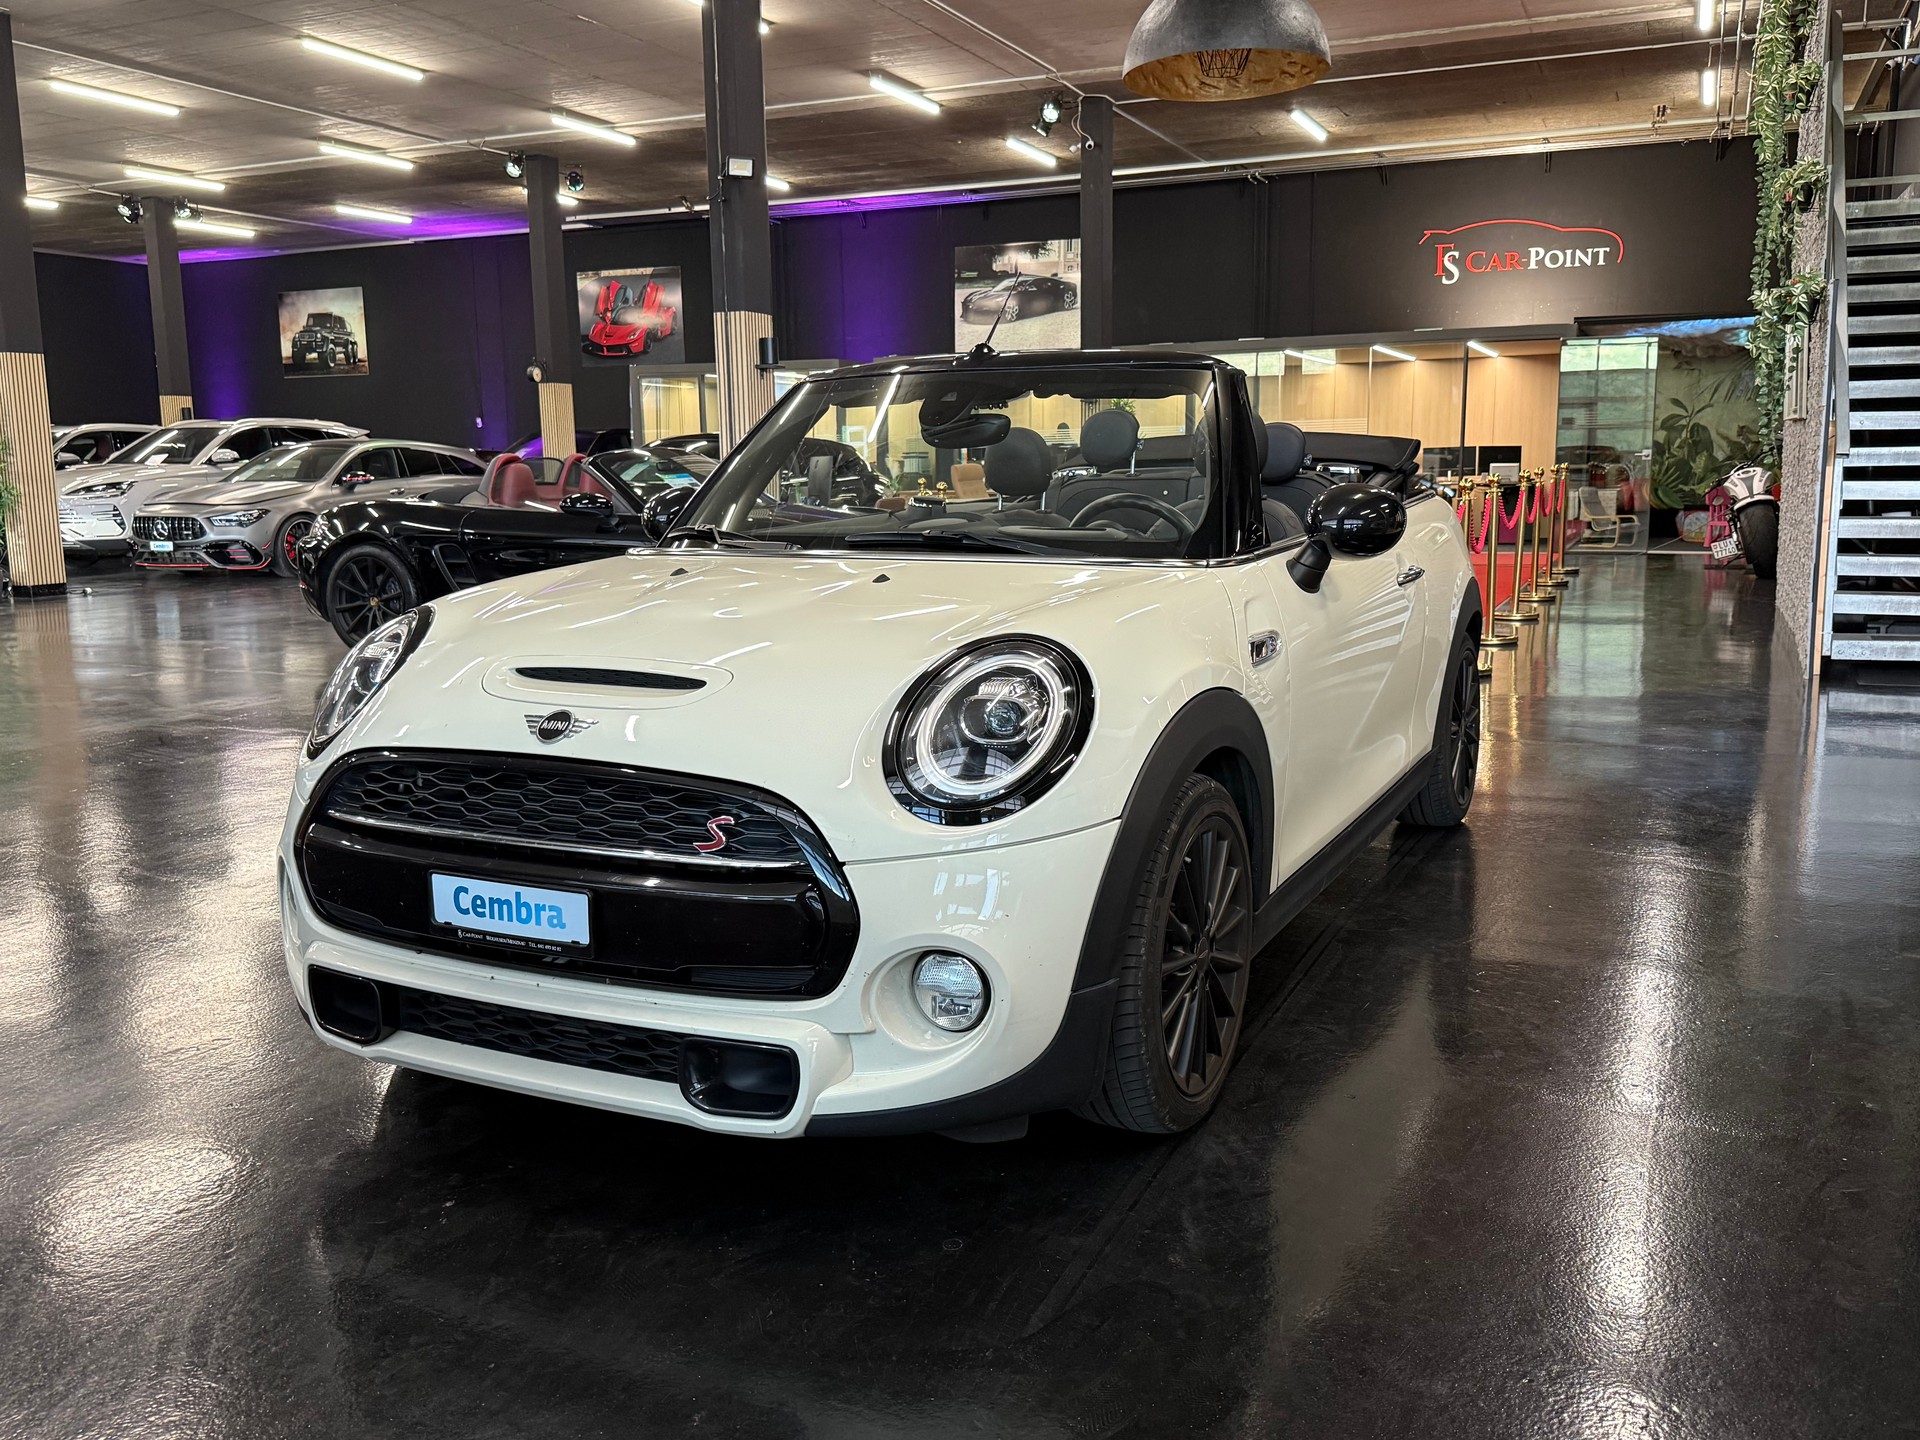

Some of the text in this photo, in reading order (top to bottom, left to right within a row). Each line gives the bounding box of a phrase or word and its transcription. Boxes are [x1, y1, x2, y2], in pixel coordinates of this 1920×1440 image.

[1465, 247, 1610, 273] CAR-POINT
[541, 720, 569, 730] MINI
[693, 816, 734, 852] S
[453, 885, 567, 930] Cembra
